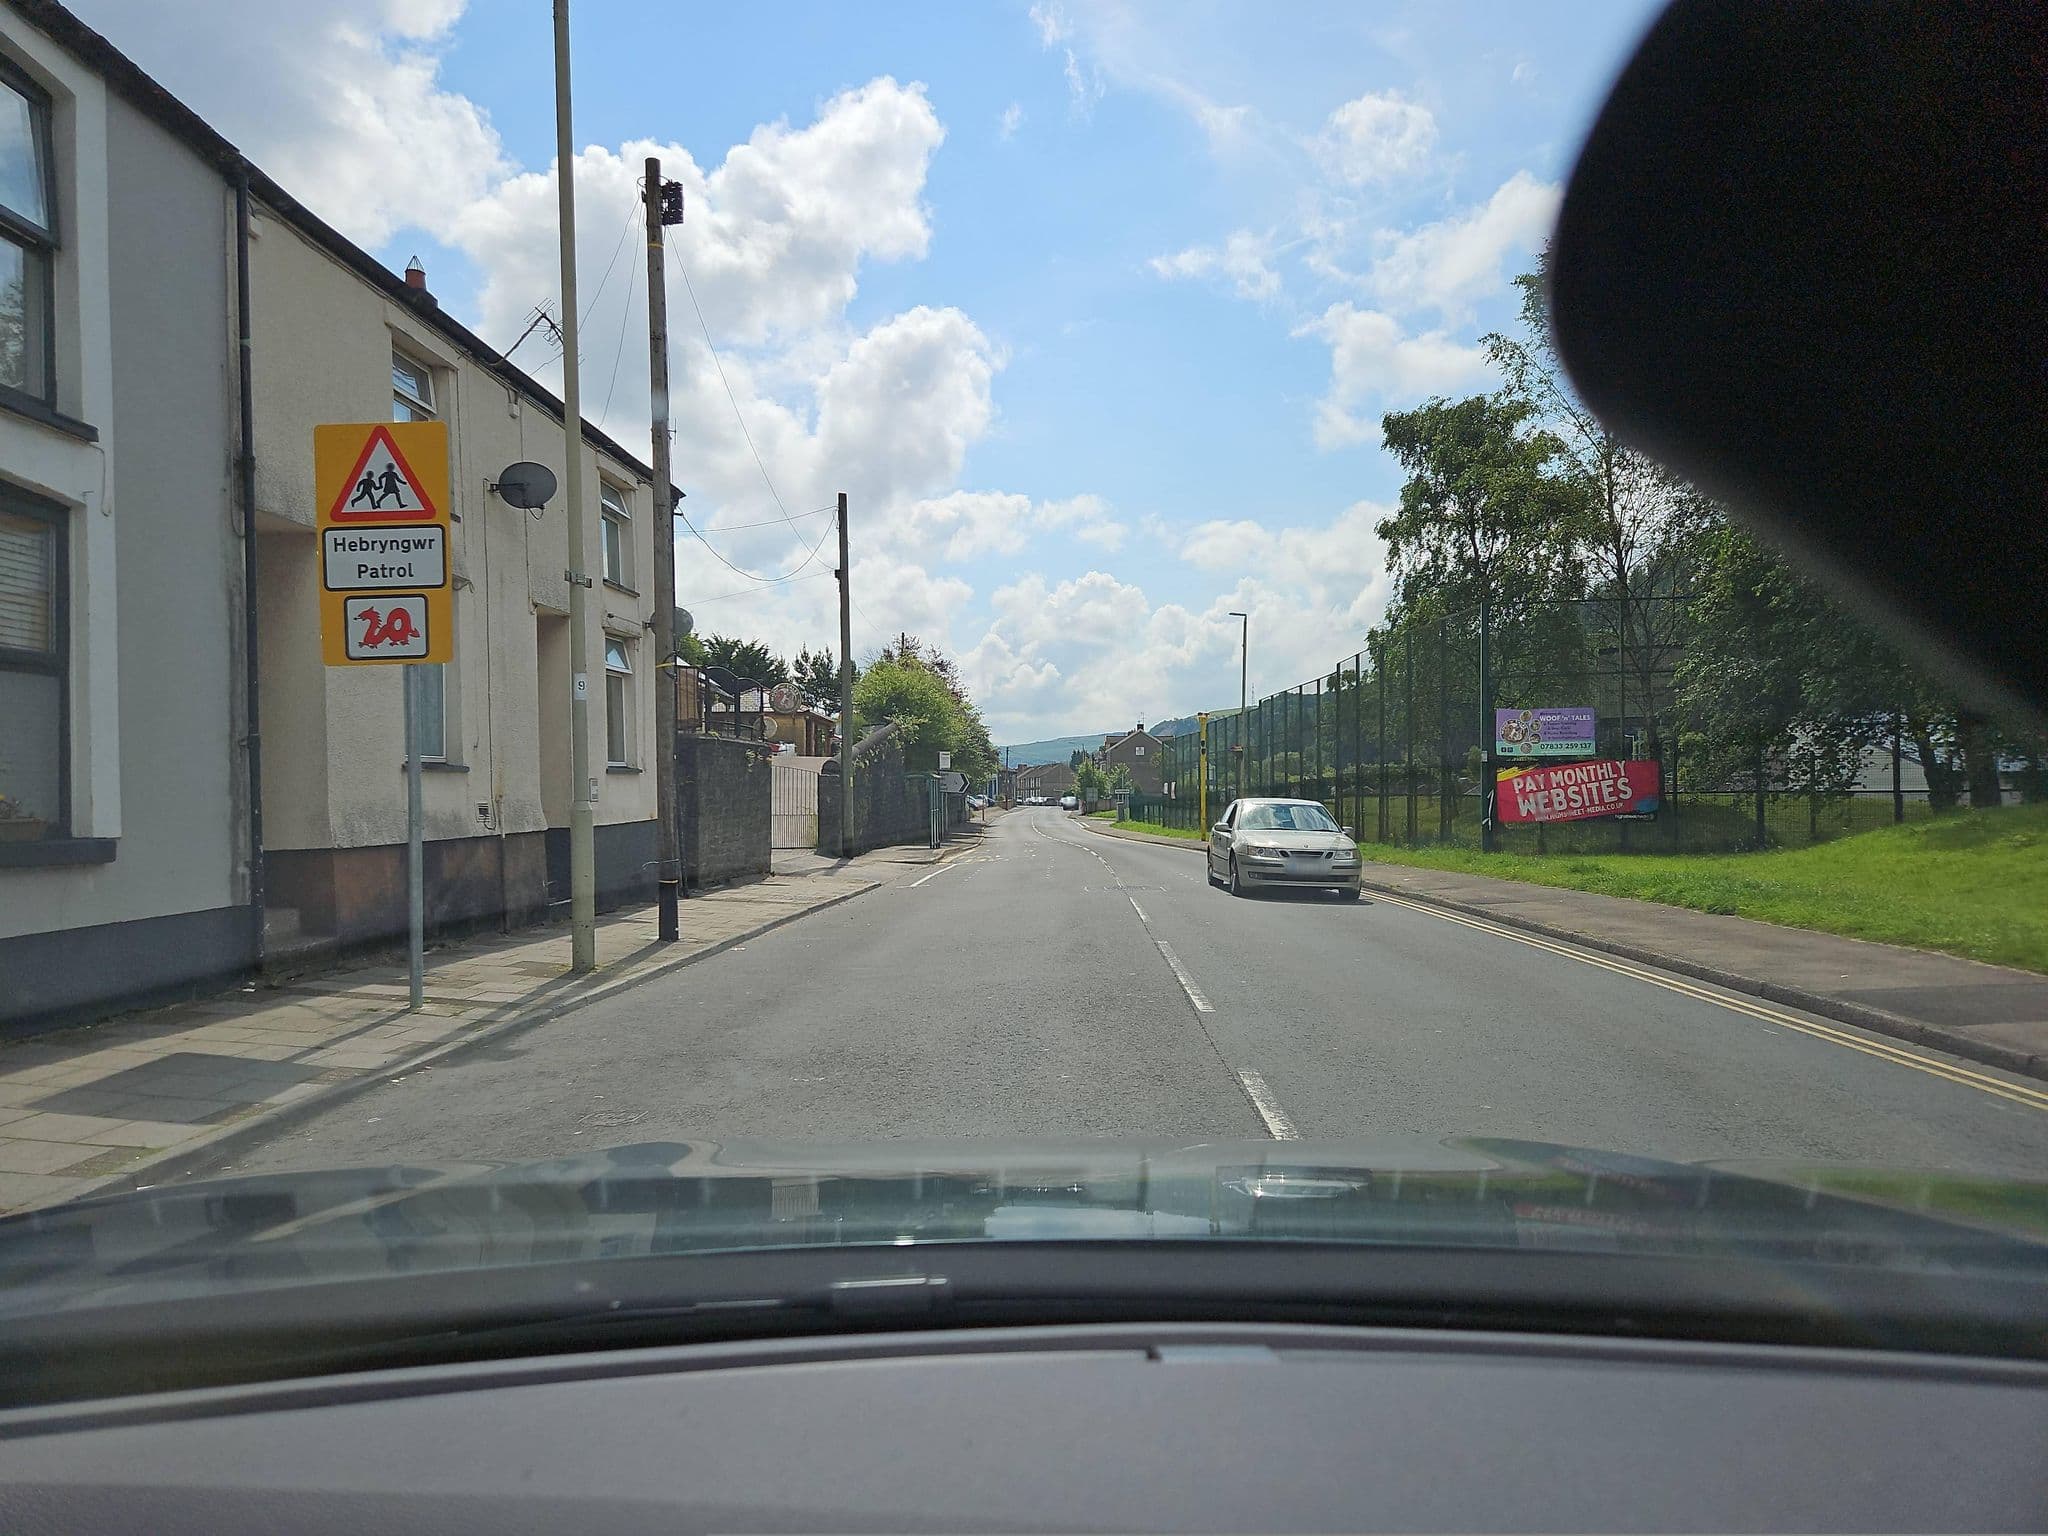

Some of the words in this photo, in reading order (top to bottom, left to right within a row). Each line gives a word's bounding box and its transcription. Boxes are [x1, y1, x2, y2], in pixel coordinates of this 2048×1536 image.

[333, 536, 435, 554] Hebryngwr
[357, 563, 414, 579] Patrol
[577, 680, 586, 691] 9
[1512, 773, 1545, 793] PAY
[1550, 760, 1626, 788] MONTHLY
[1516, 777, 1633, 818] WEBSITES
